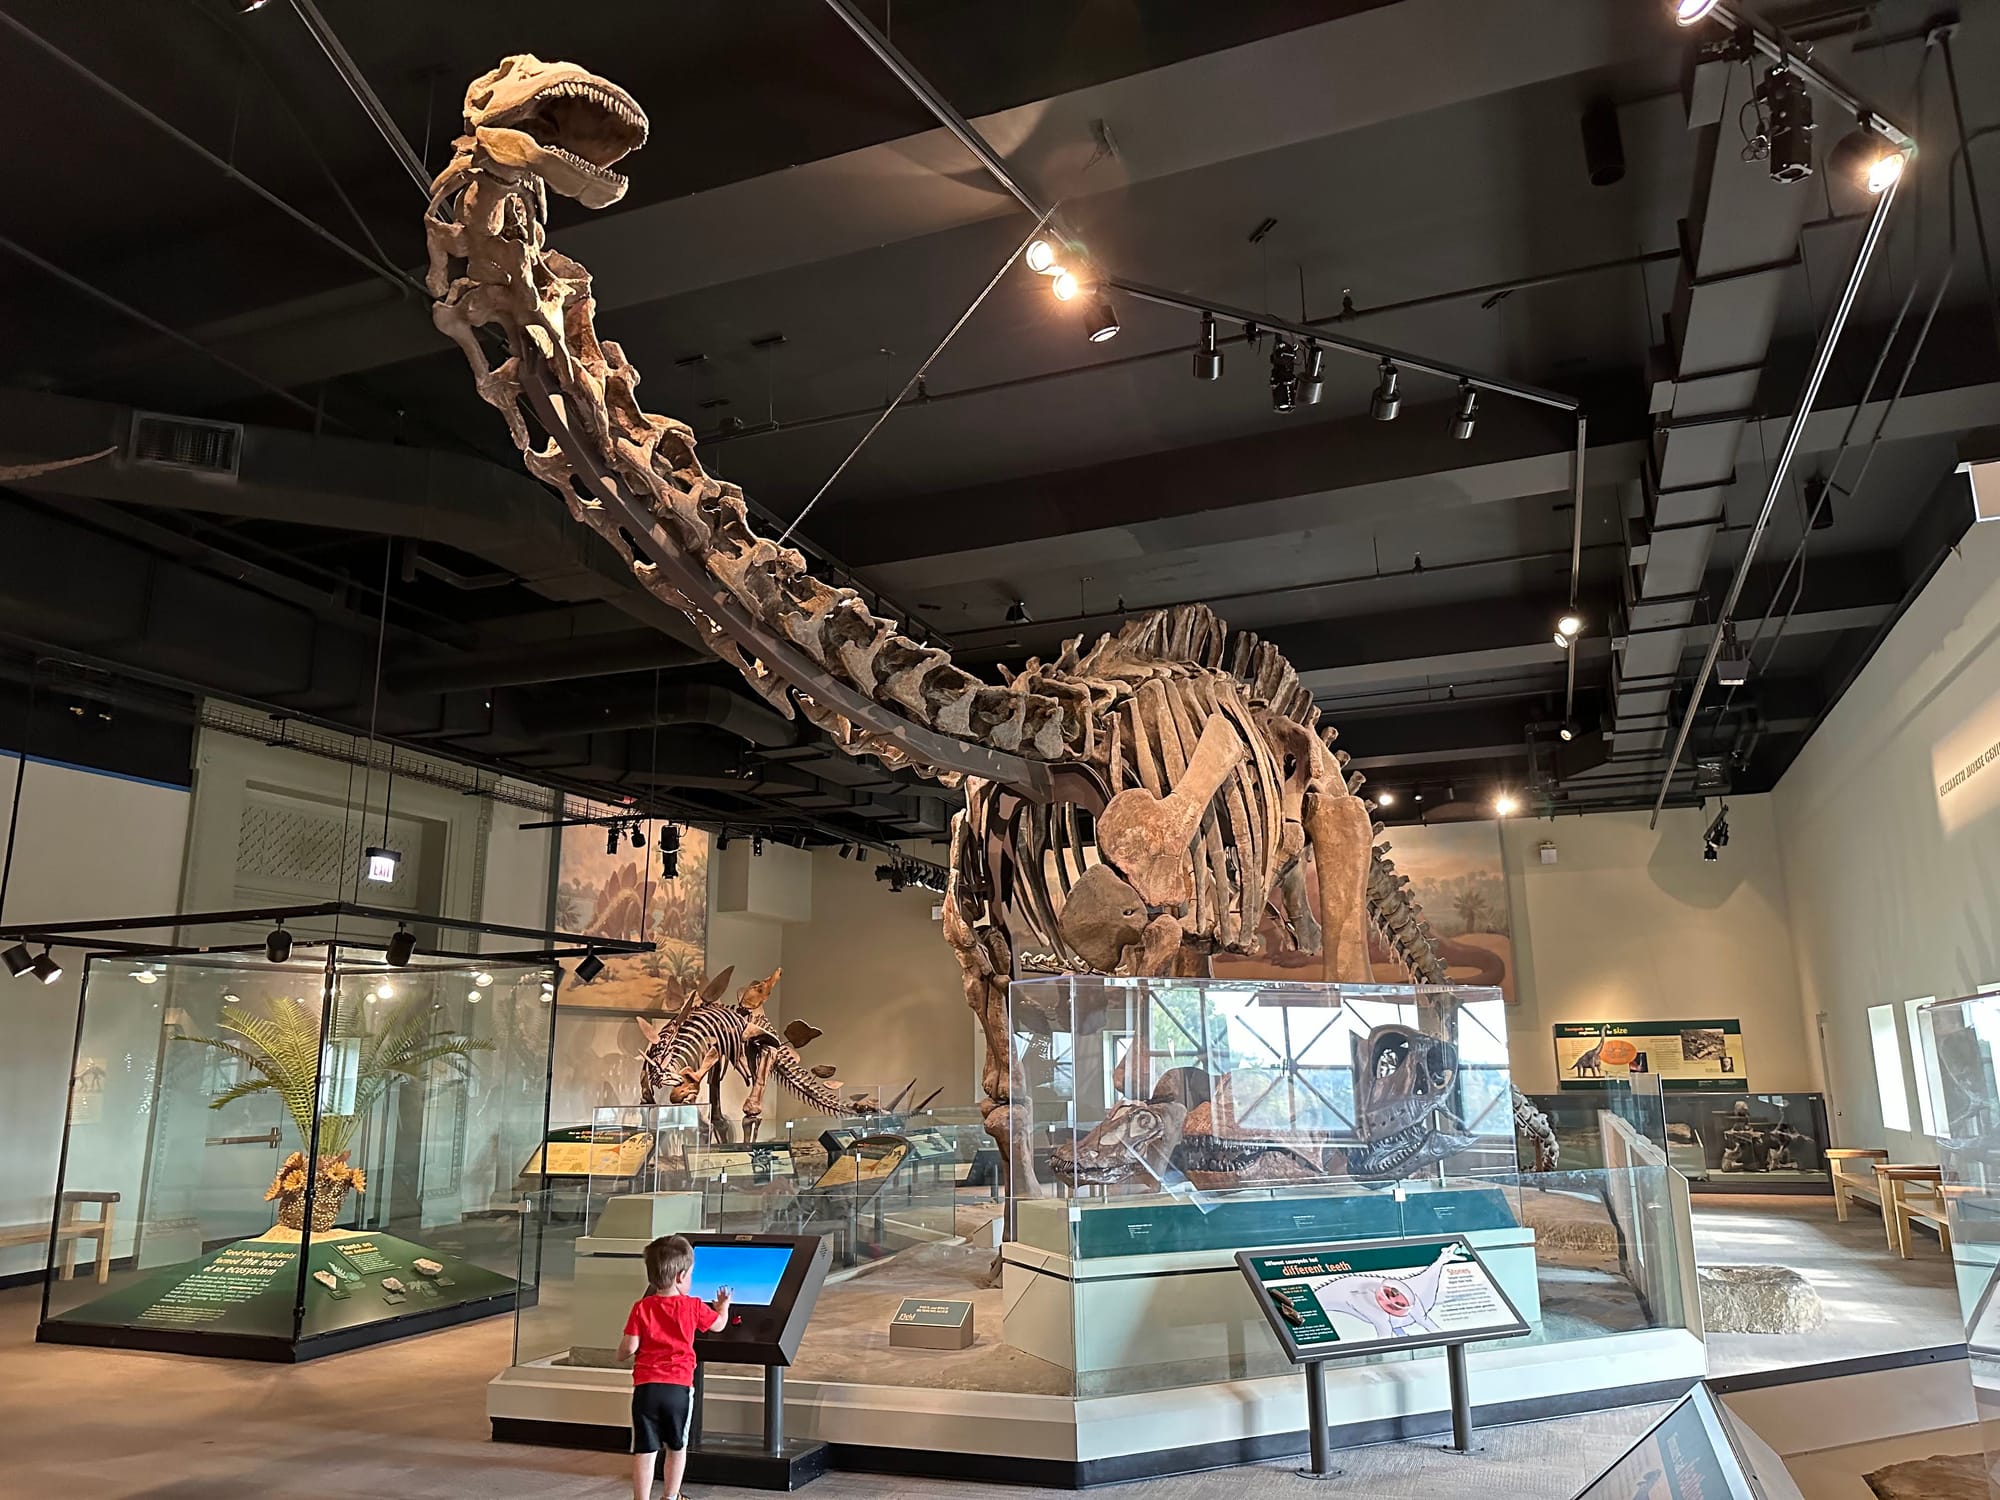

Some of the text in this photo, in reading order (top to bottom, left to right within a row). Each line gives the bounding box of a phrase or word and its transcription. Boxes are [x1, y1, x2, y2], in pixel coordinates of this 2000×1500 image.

[373, 863, 390, 878] EXIT
[1613, 1026, 1628, 1034] size
[336, 1243, 362, 1251] Plants
[222, 1248, 272, 1259] Seed-bearing
[213, 1256, 287, 1267] formed the roots
[225, 1266, 277, 1276] ecosystem
[1282, 1260, 1352, 1276] different teeth
